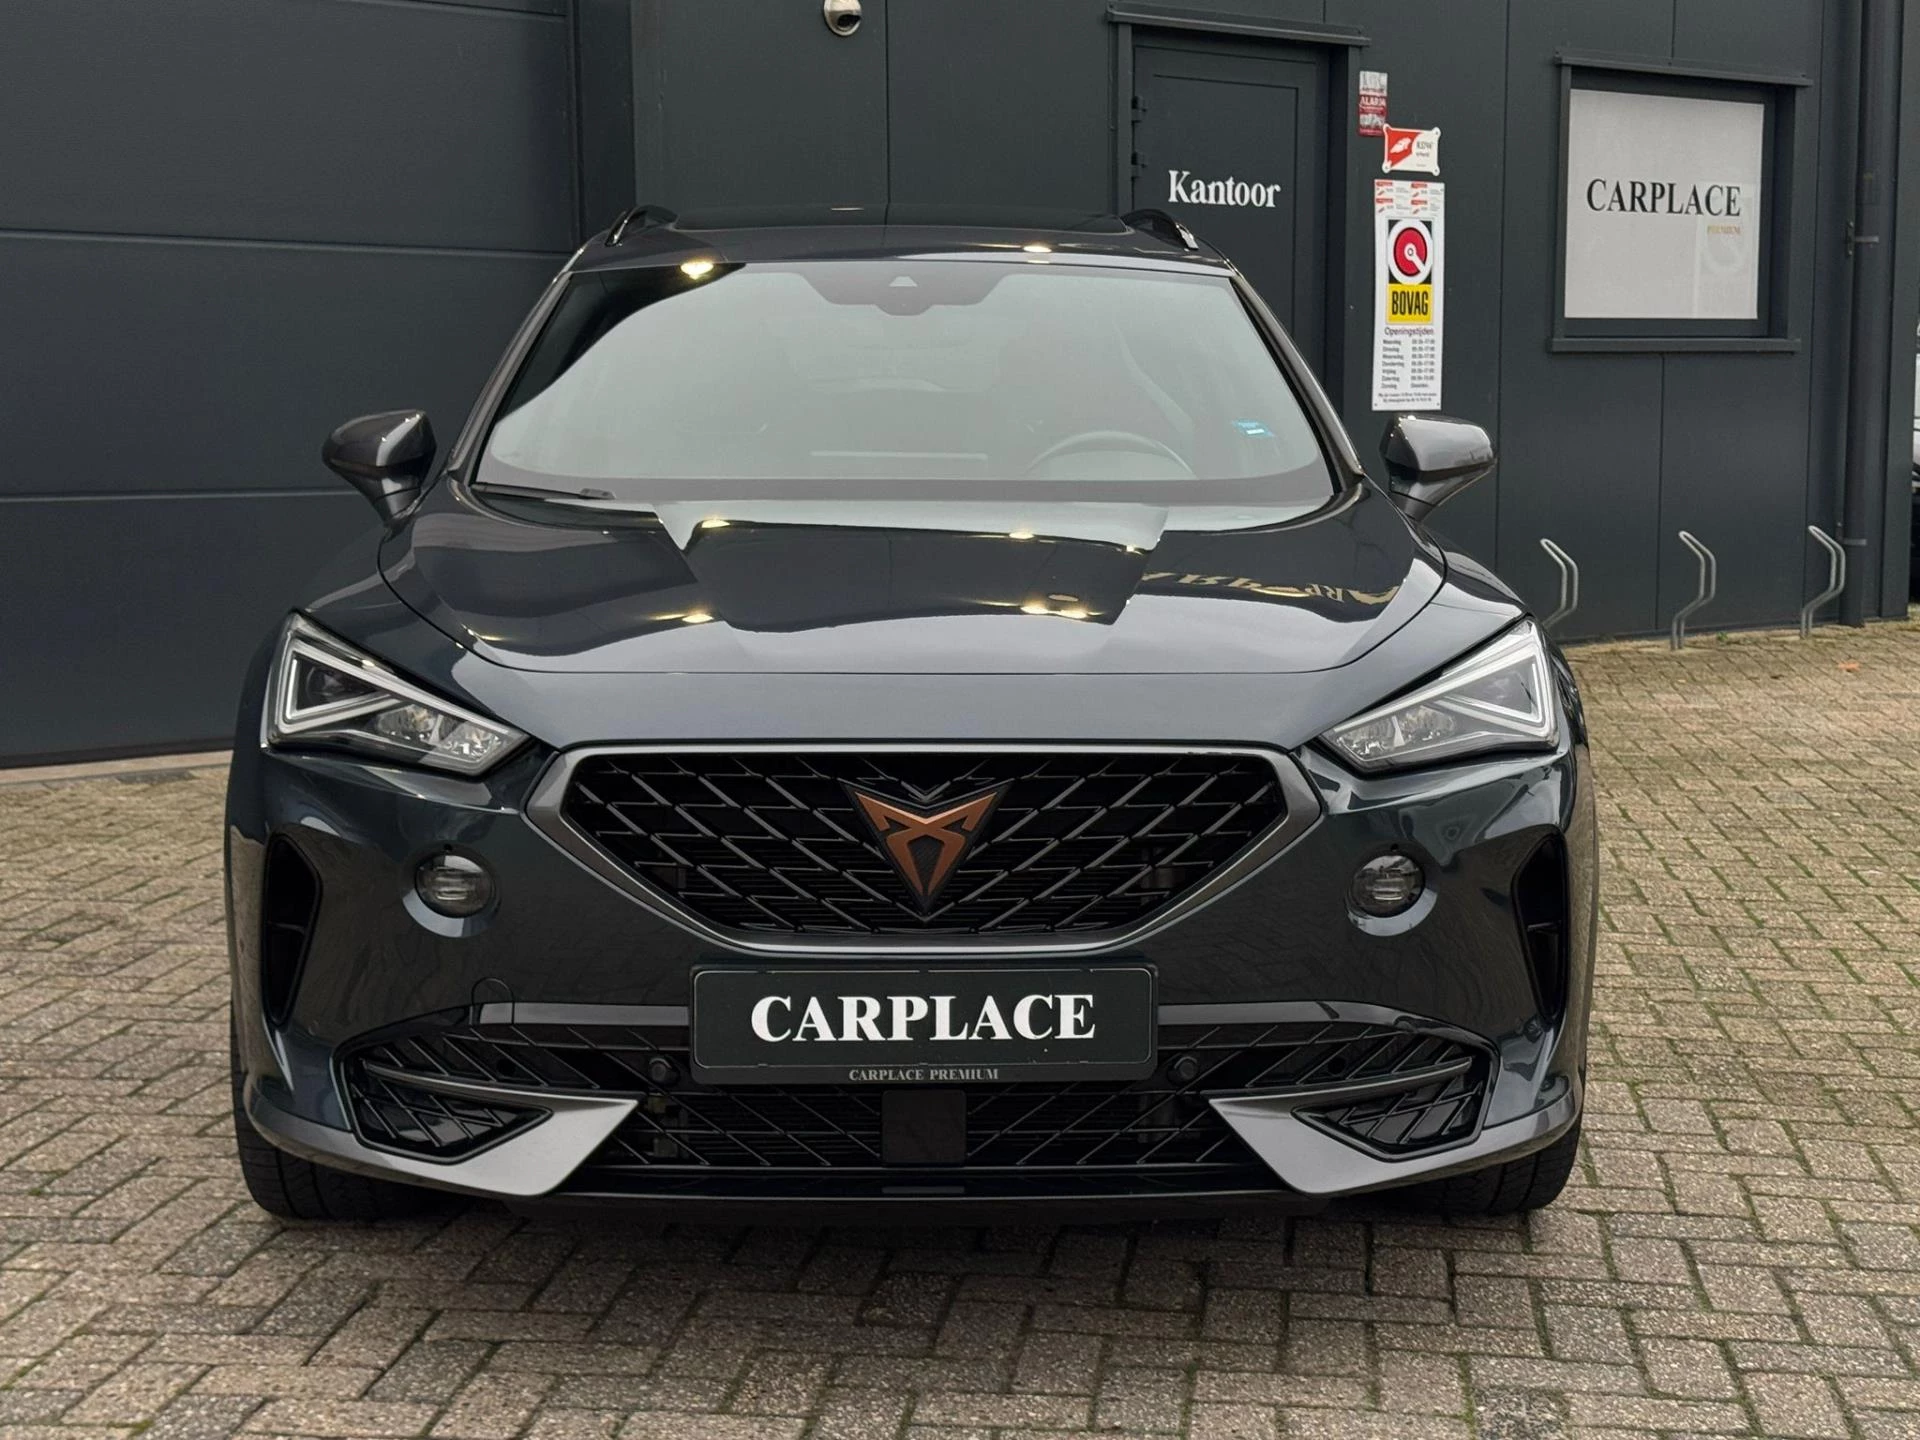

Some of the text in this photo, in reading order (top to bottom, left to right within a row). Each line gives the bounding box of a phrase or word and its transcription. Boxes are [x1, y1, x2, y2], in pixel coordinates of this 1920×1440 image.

[1168, 170, 1281, 207] Kantoor
[1587, 178, 1741, 217] CARPLACE
[1391, 290, 1429, 316] BOVAG
[1384, 326, 1434, 337] Openingstijden
[751, 994, 1096, 1042] CARPLACE
[848, 1068, 999, 1081] CARPLACE PREMIUM
